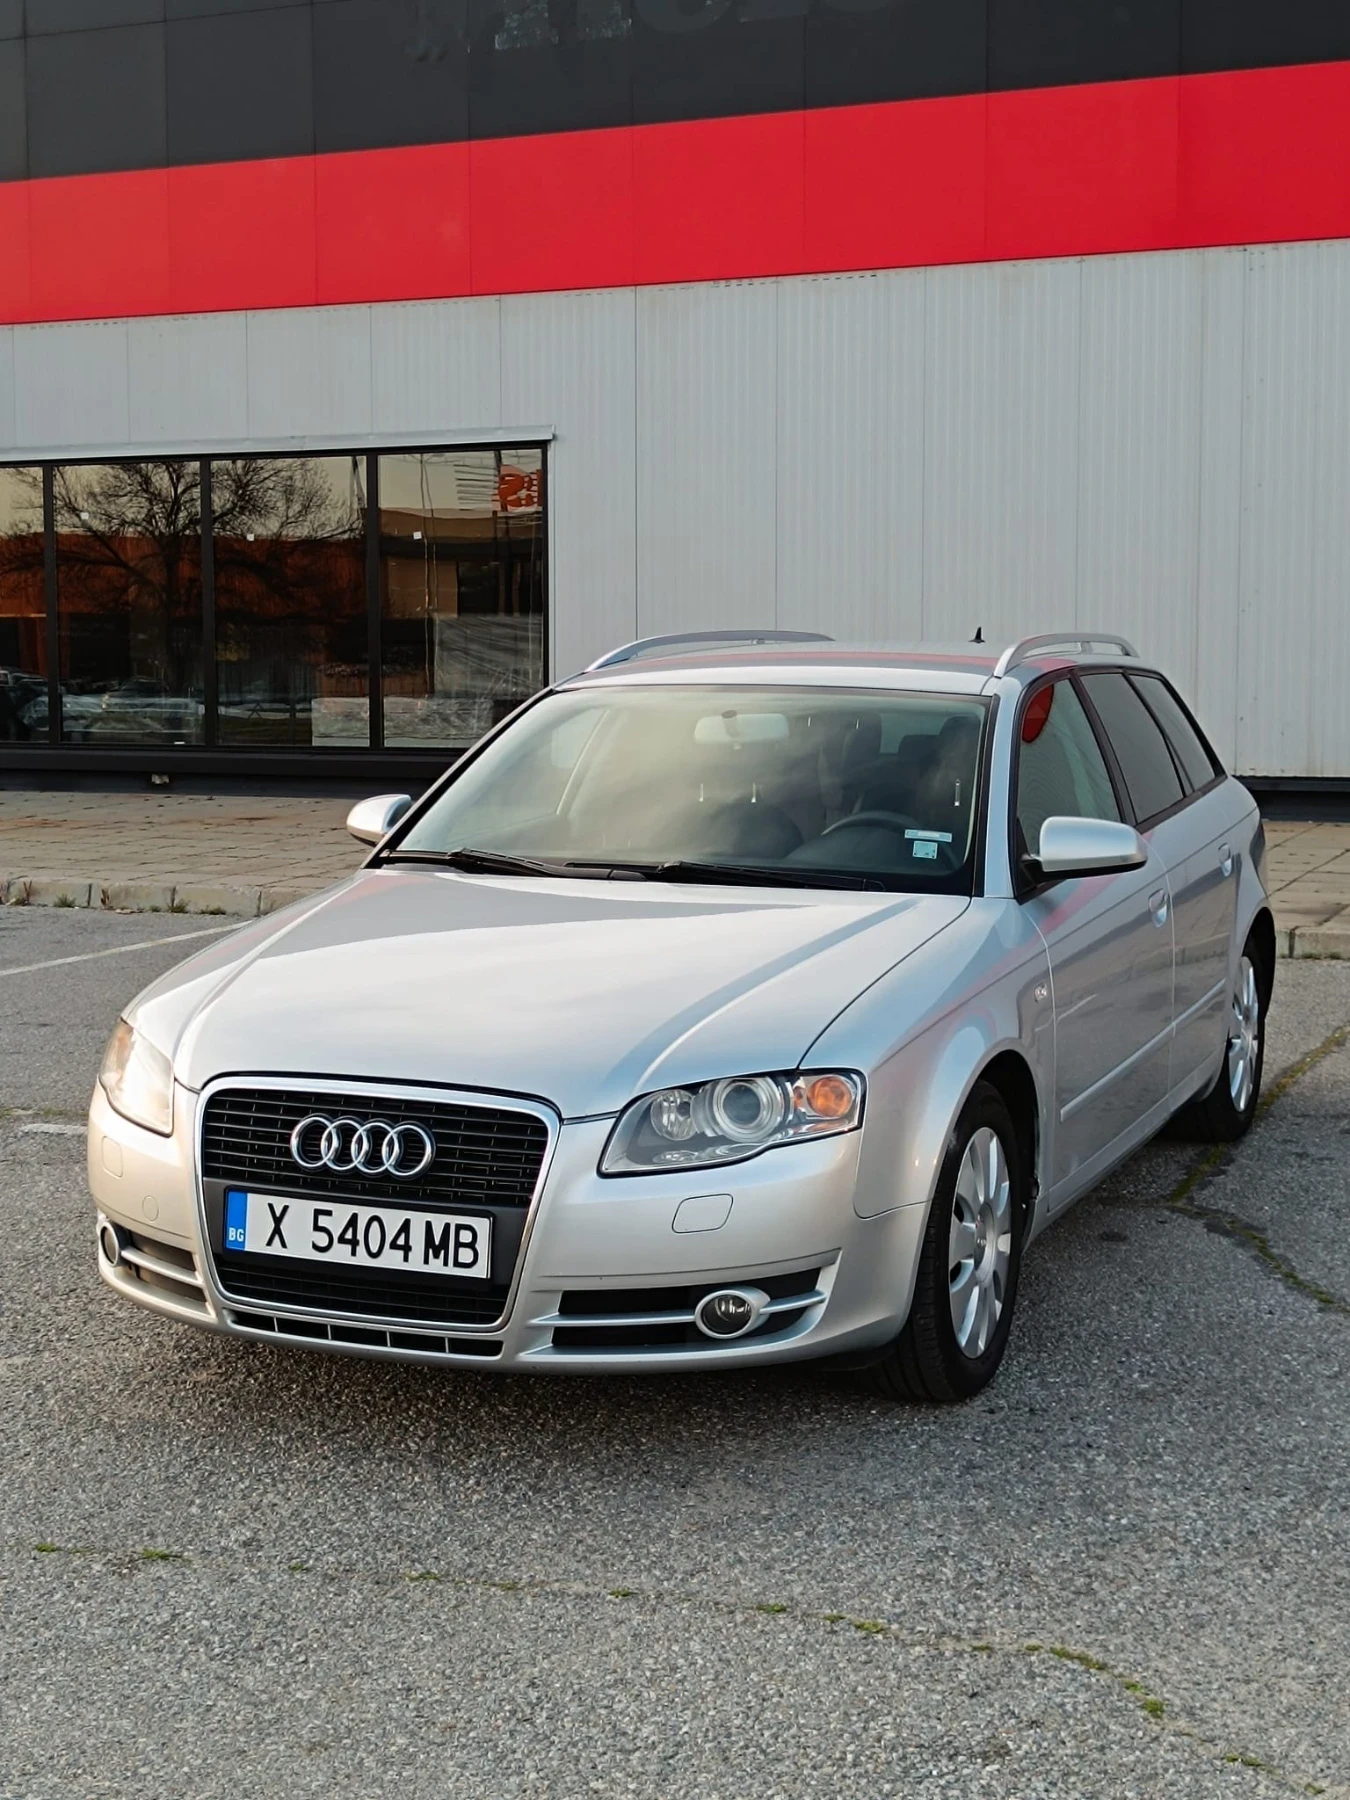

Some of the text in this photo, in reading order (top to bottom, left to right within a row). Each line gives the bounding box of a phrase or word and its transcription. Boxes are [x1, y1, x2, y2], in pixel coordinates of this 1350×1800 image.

[228, 1227, 244, 1242] BG
[265, 1202, 479, 1269] X 5404 MB
